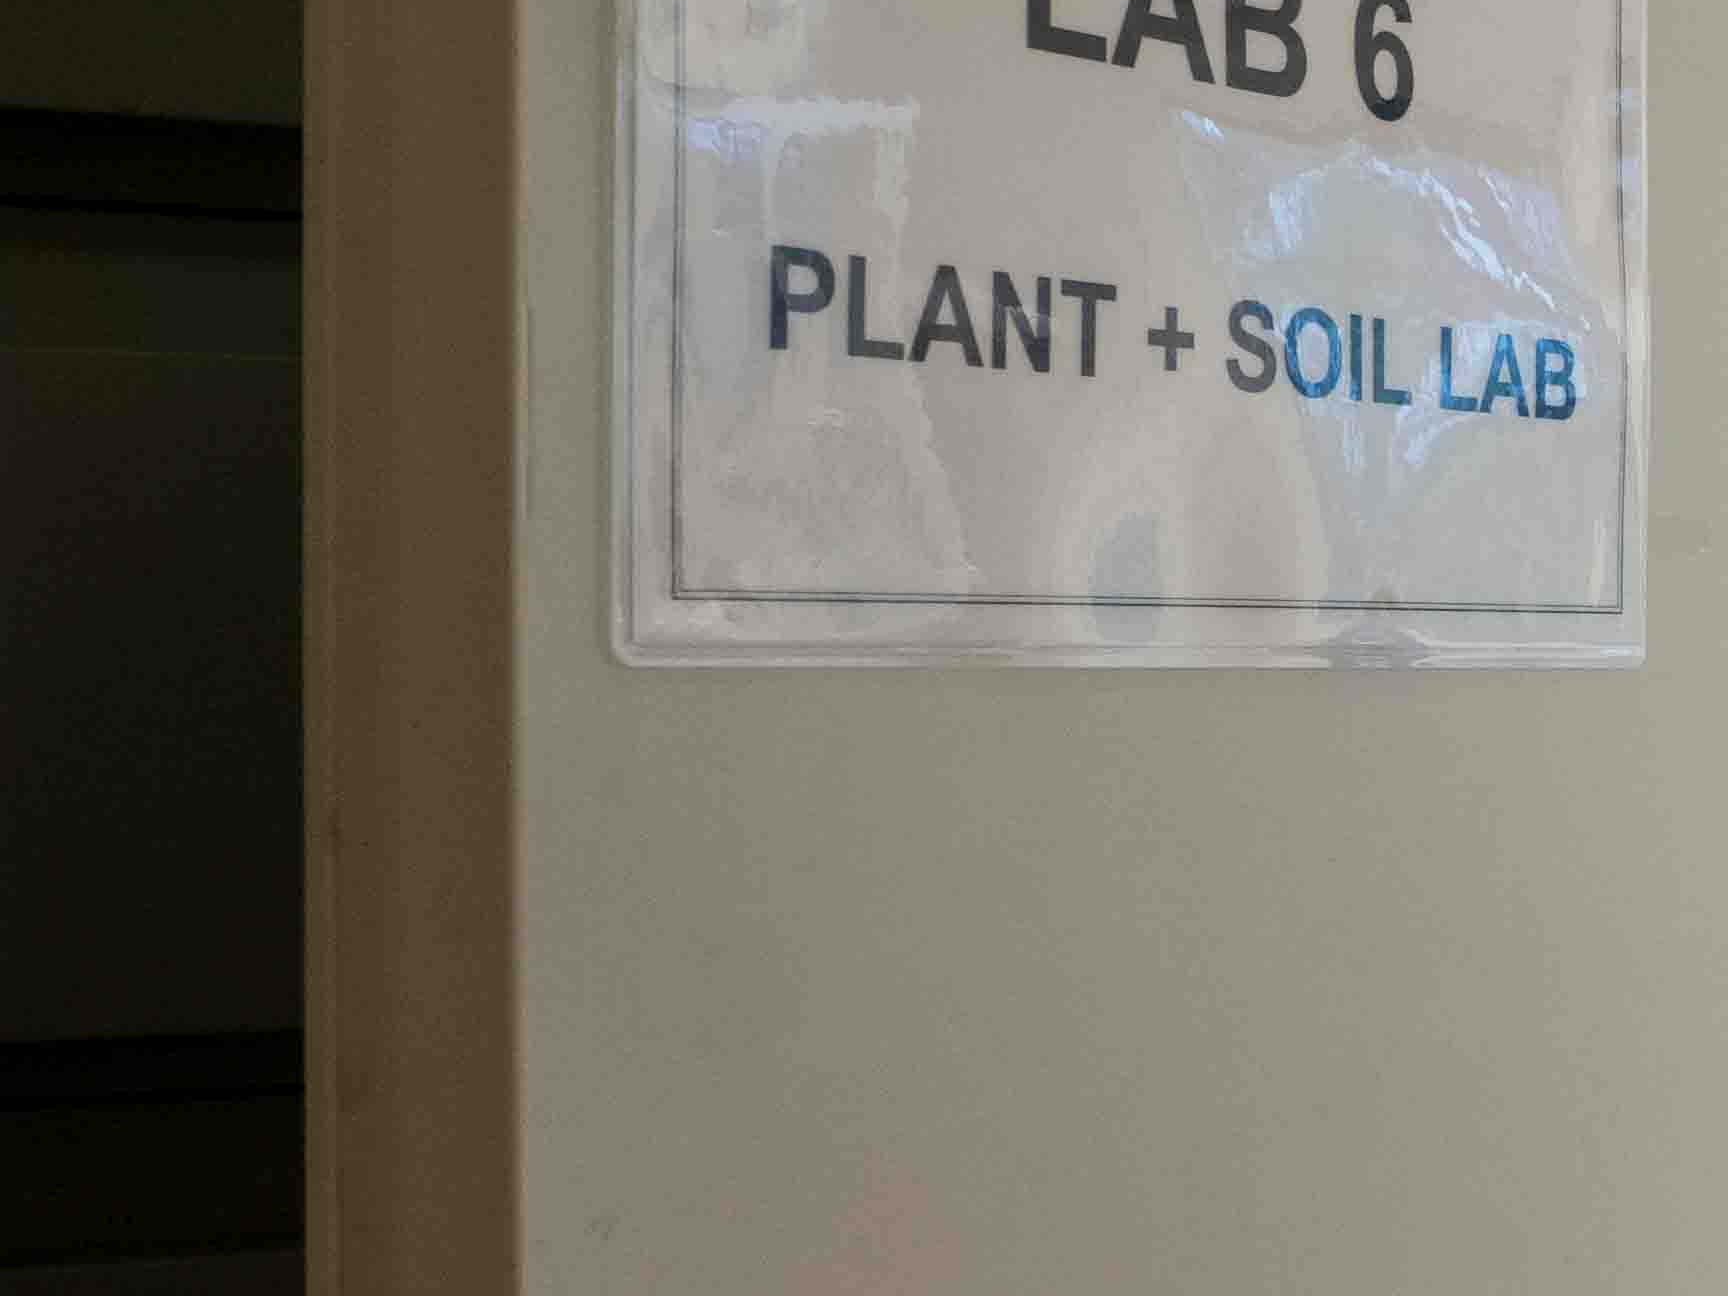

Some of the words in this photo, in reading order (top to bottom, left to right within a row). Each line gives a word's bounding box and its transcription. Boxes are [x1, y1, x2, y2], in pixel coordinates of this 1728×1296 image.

[768, 244, 1116, 378] PLANT
[1147, 306, 1195, 371] +
[1226, 299, 1411, 407] SOIL
[1440, 327, 1578, 422] LAB
